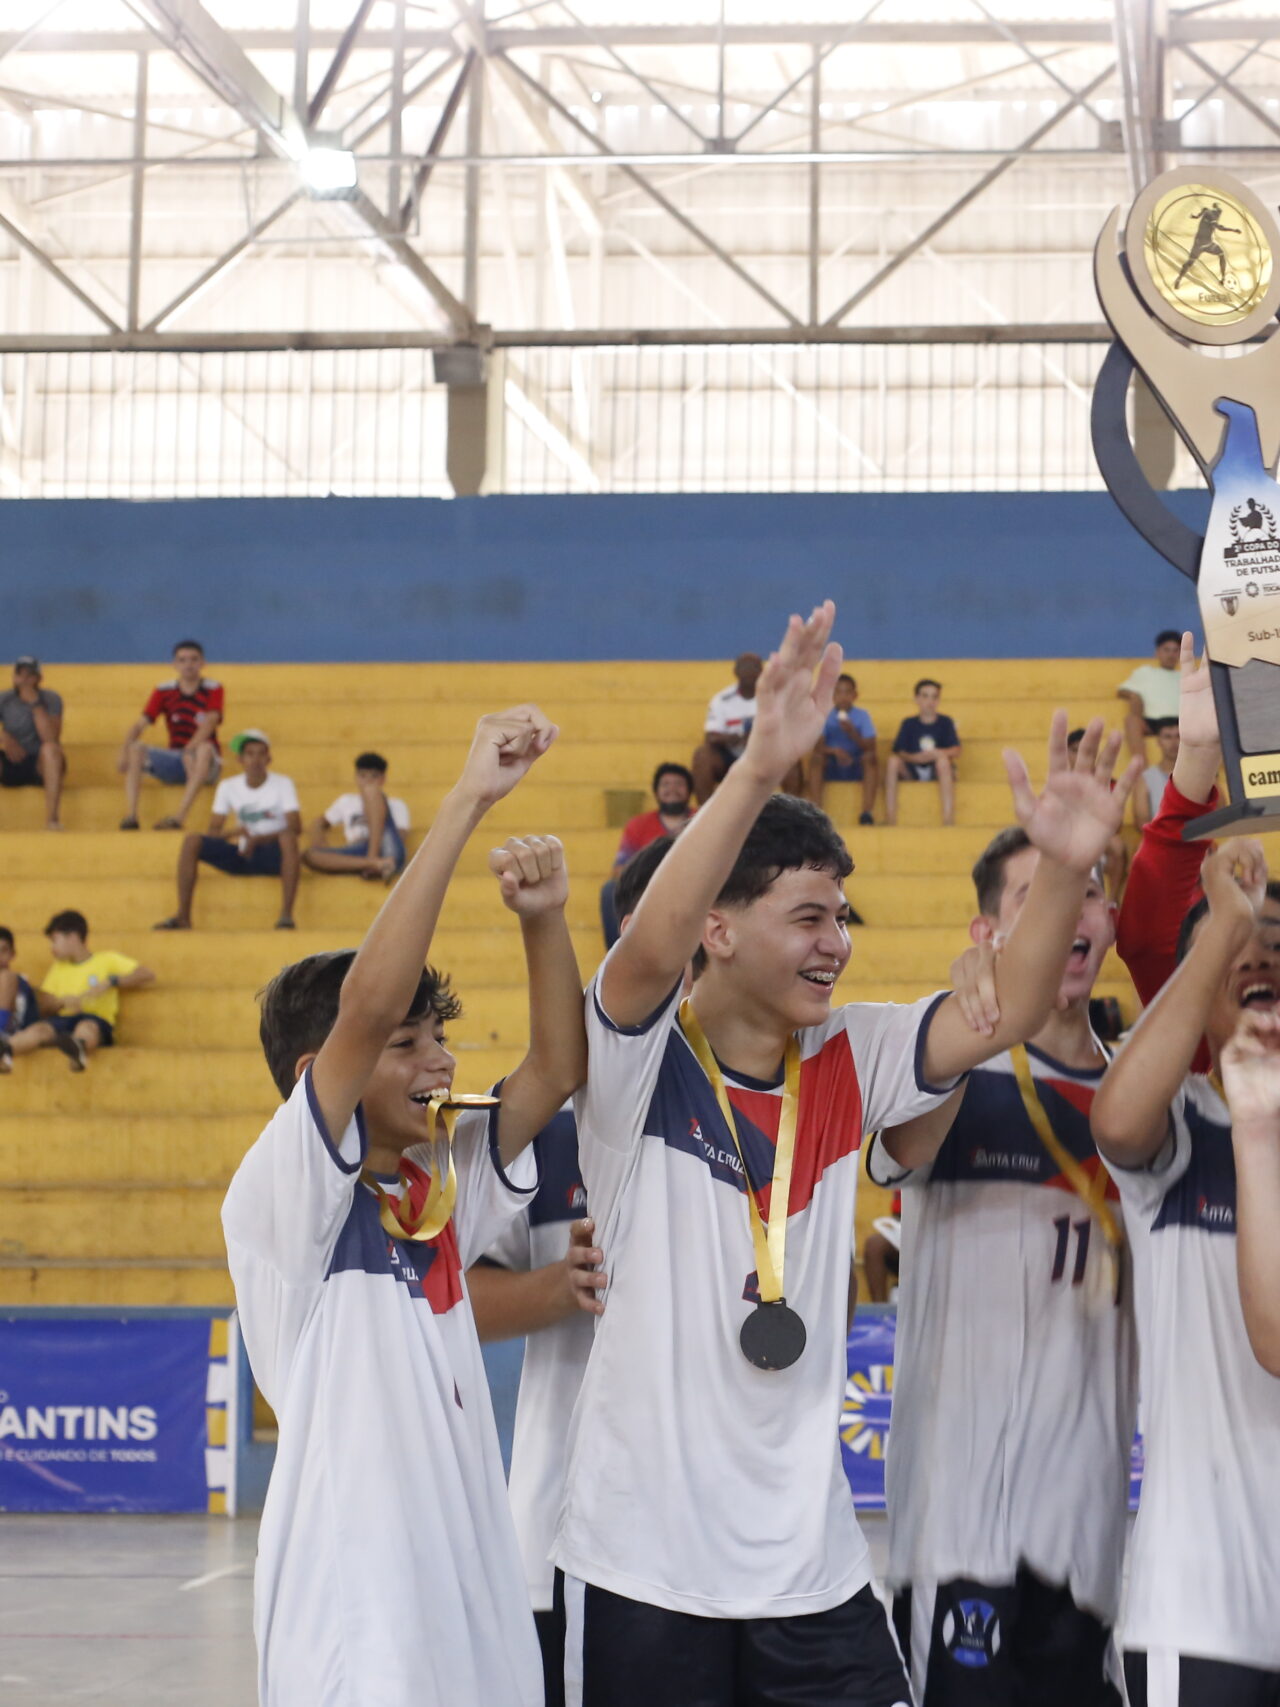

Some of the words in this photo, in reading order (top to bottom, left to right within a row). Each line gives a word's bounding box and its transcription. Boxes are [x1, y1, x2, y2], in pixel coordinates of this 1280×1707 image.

[1243, 541, 1266, 552] COPA
[1266, 540, 1280, 550] DO
[1236, 567, 1249, 577] DE
[1011, 1153, 1041, 1172] CRUZ
[1050, 1216, 1092, 1288] 11
[16, 1449, 88, 1462] CUIDANDO
[89, 1450, 108, 1462] DE
[110, 1449, 158, 1462] TODOS
